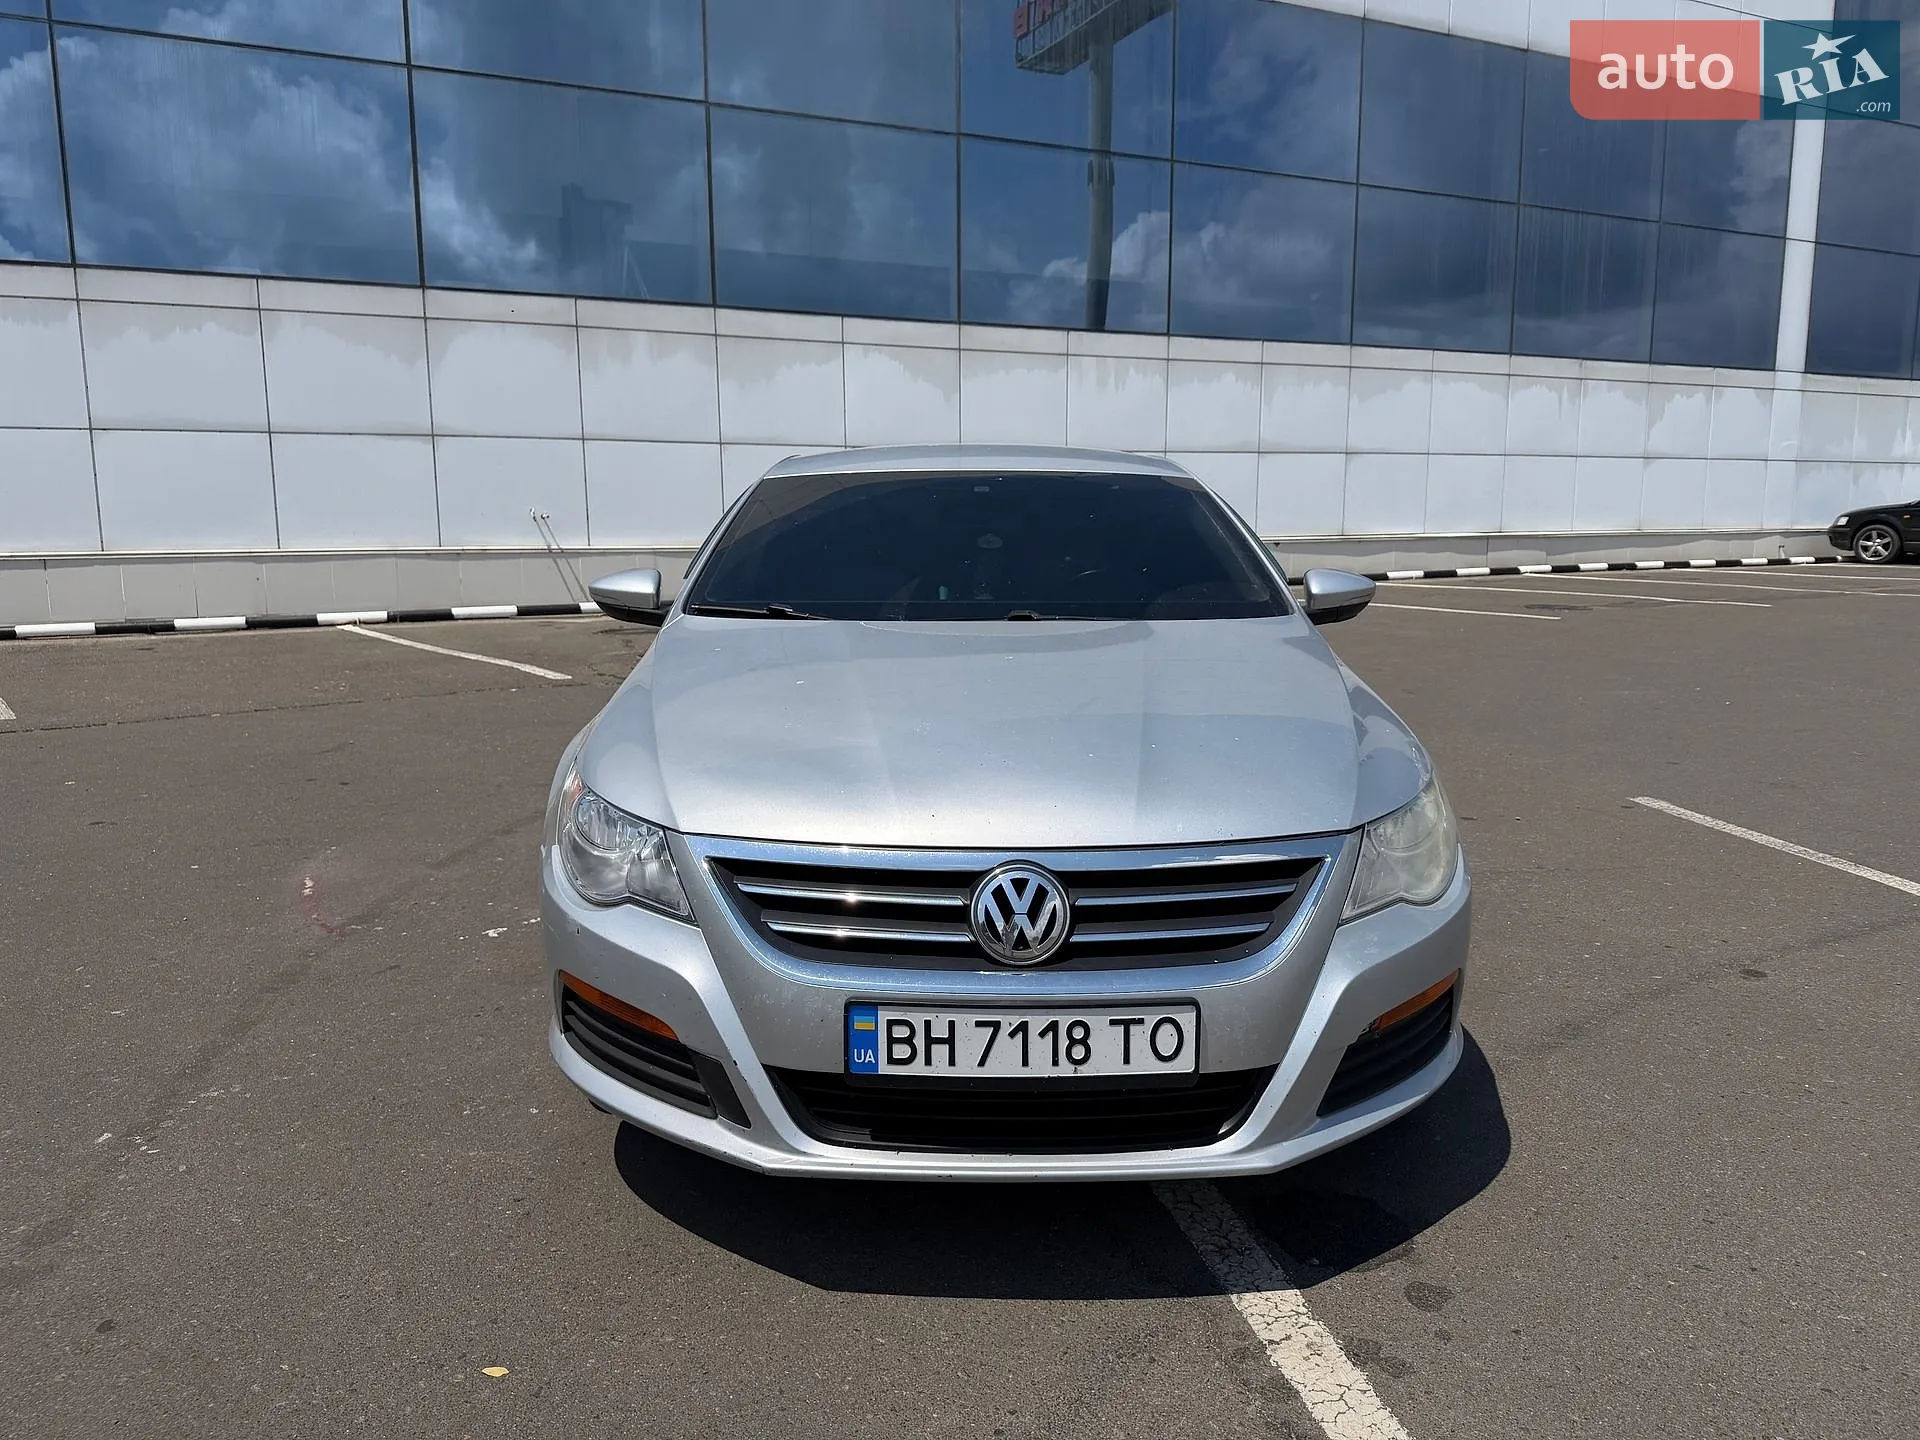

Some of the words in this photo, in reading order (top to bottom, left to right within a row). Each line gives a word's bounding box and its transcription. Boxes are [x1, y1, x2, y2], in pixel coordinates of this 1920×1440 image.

[853, 1048, 876, 1064] UA
[886, 1018, 956, 1067] BH
[974, 1019, 1092, 1067] 7118
[1109, 1016, 1185, 1065] TO
